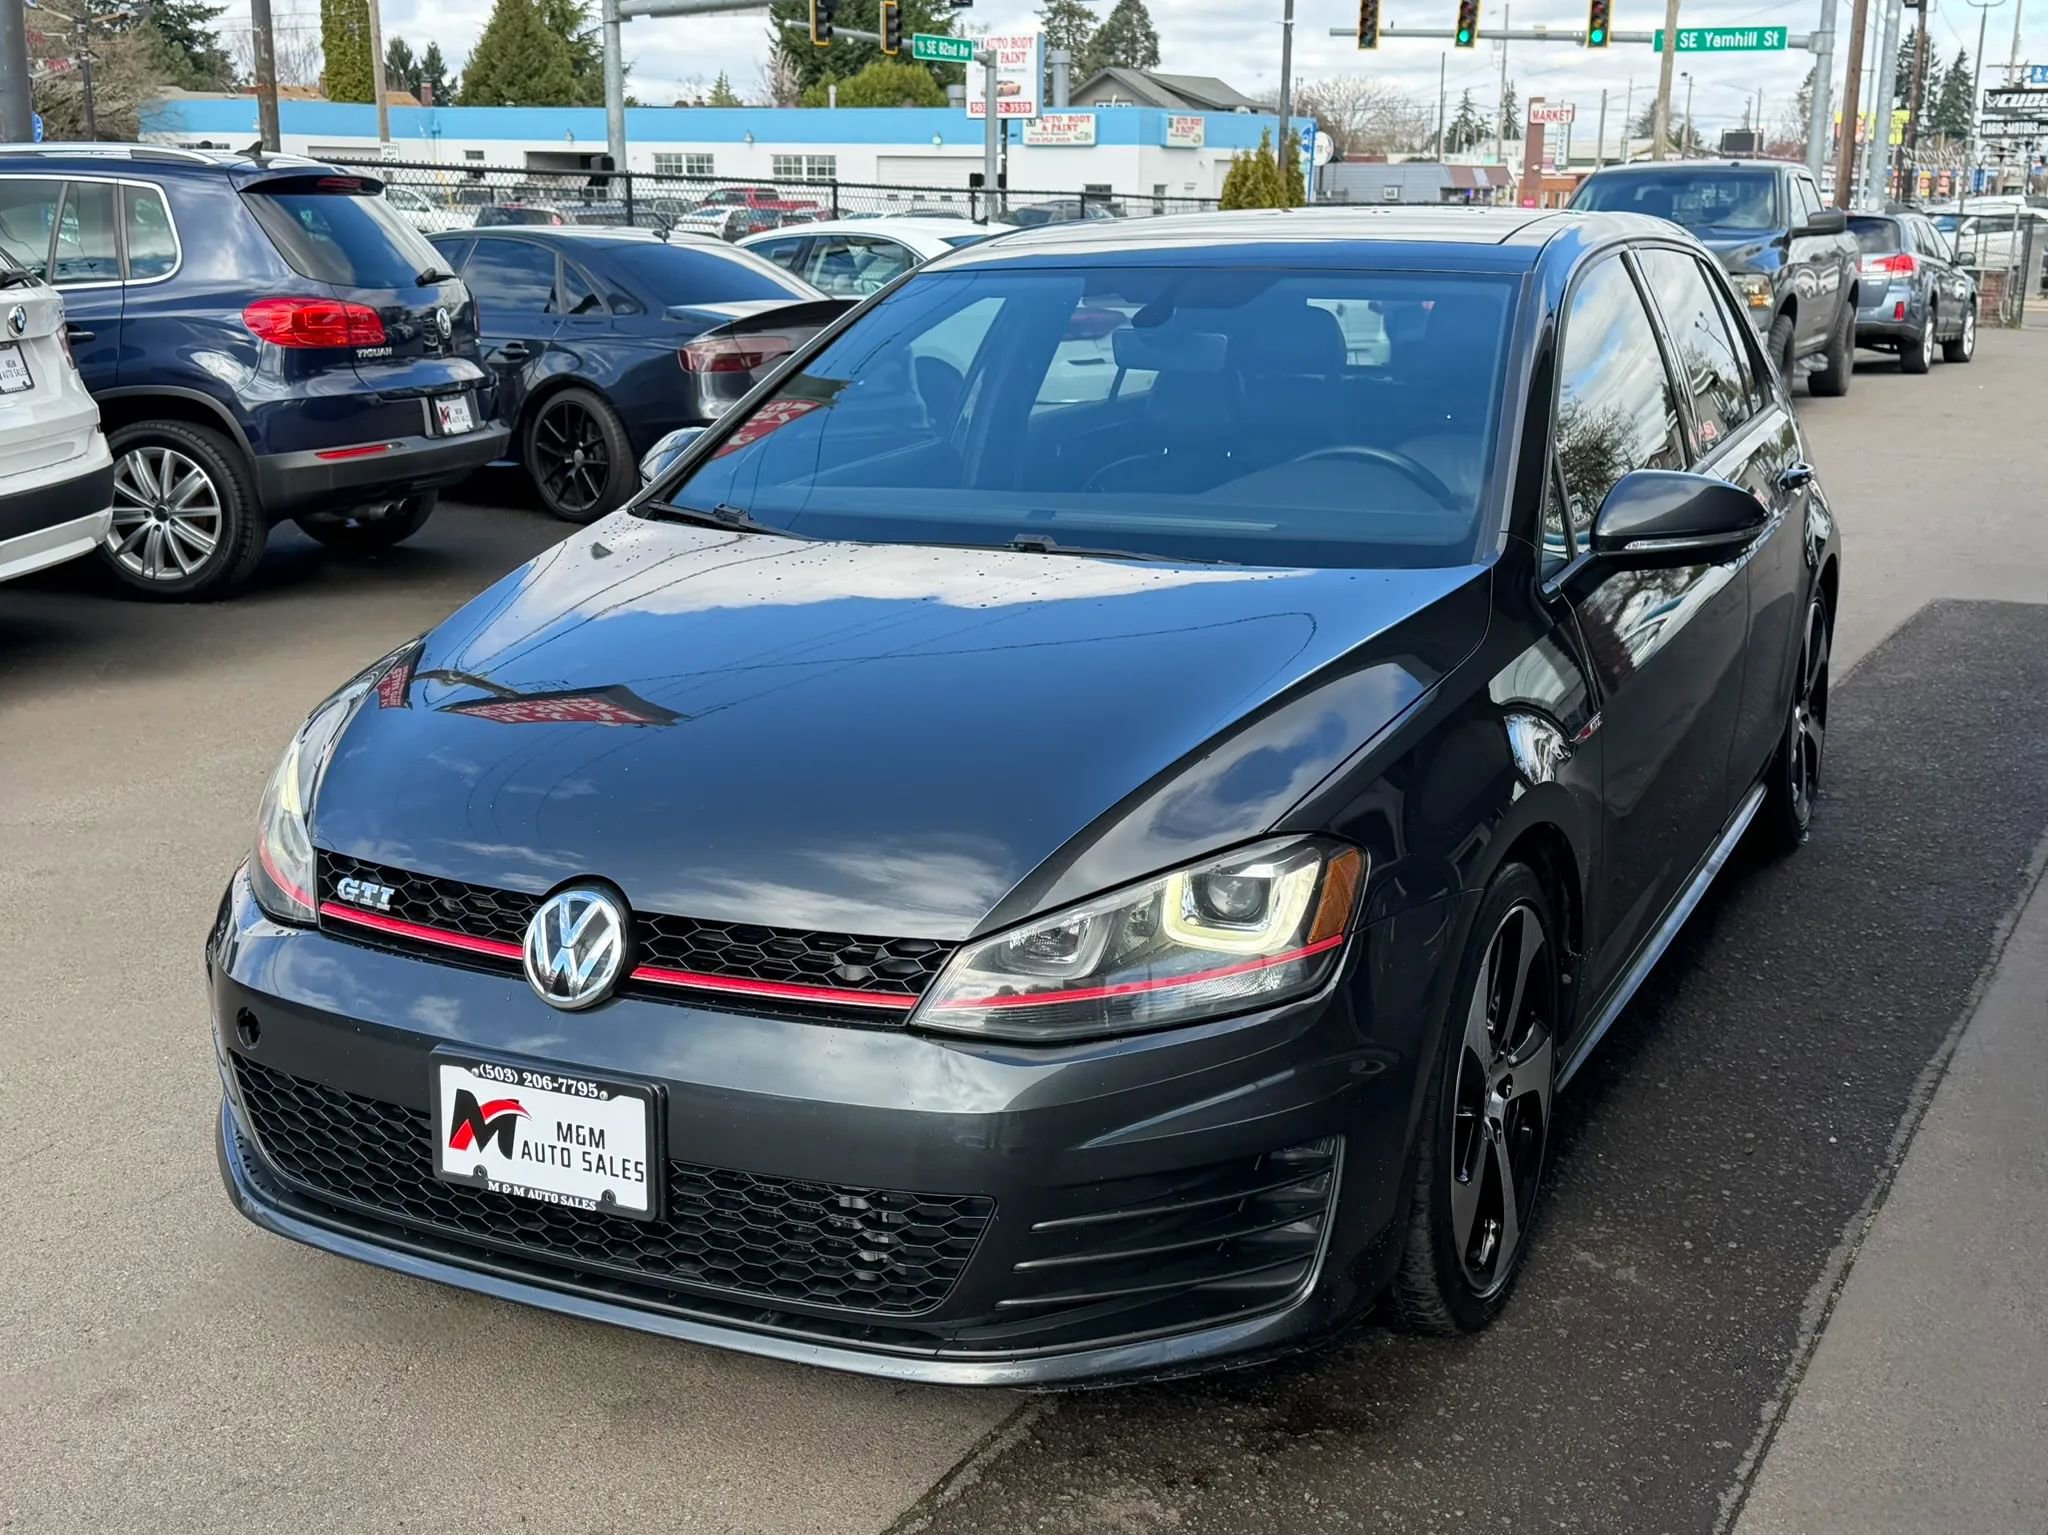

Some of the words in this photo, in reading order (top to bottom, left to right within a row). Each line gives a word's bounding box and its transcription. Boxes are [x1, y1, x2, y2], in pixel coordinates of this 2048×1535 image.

[926, 40, 937, 55] SE
[938, 41, 957, 56] 82nd
[1680, 32, 1698, 48] SE
[1704, 31, 1758, 47] Yamhill
[1763, 30, 1780, 47] St
[1000, 51, 1026, 63] PAINT
[1532, 110, 1572, 121] MARKET
[1051, 123, 1079, 132] PAINT
[356, 346, 393, 358] TIGUAN
[337, 877, 396, 911] GTI
[479, 1063, 519, 1084] (503)
[522, 1071, 599, 1098] 206-7795
[556, 1121, 606, 1150] M&M
[521, 1140, 572, 1169] AUTO
[582, 1152, 645, 1183] SALES
[487, 1180, 502, 1194] M
[502, 1183, 512, 1195] &
[512, 1186, 527, 1197] M
[527, 1189, 559, 1205] AUTO
[560, 1193, 597, 1212] SALES
